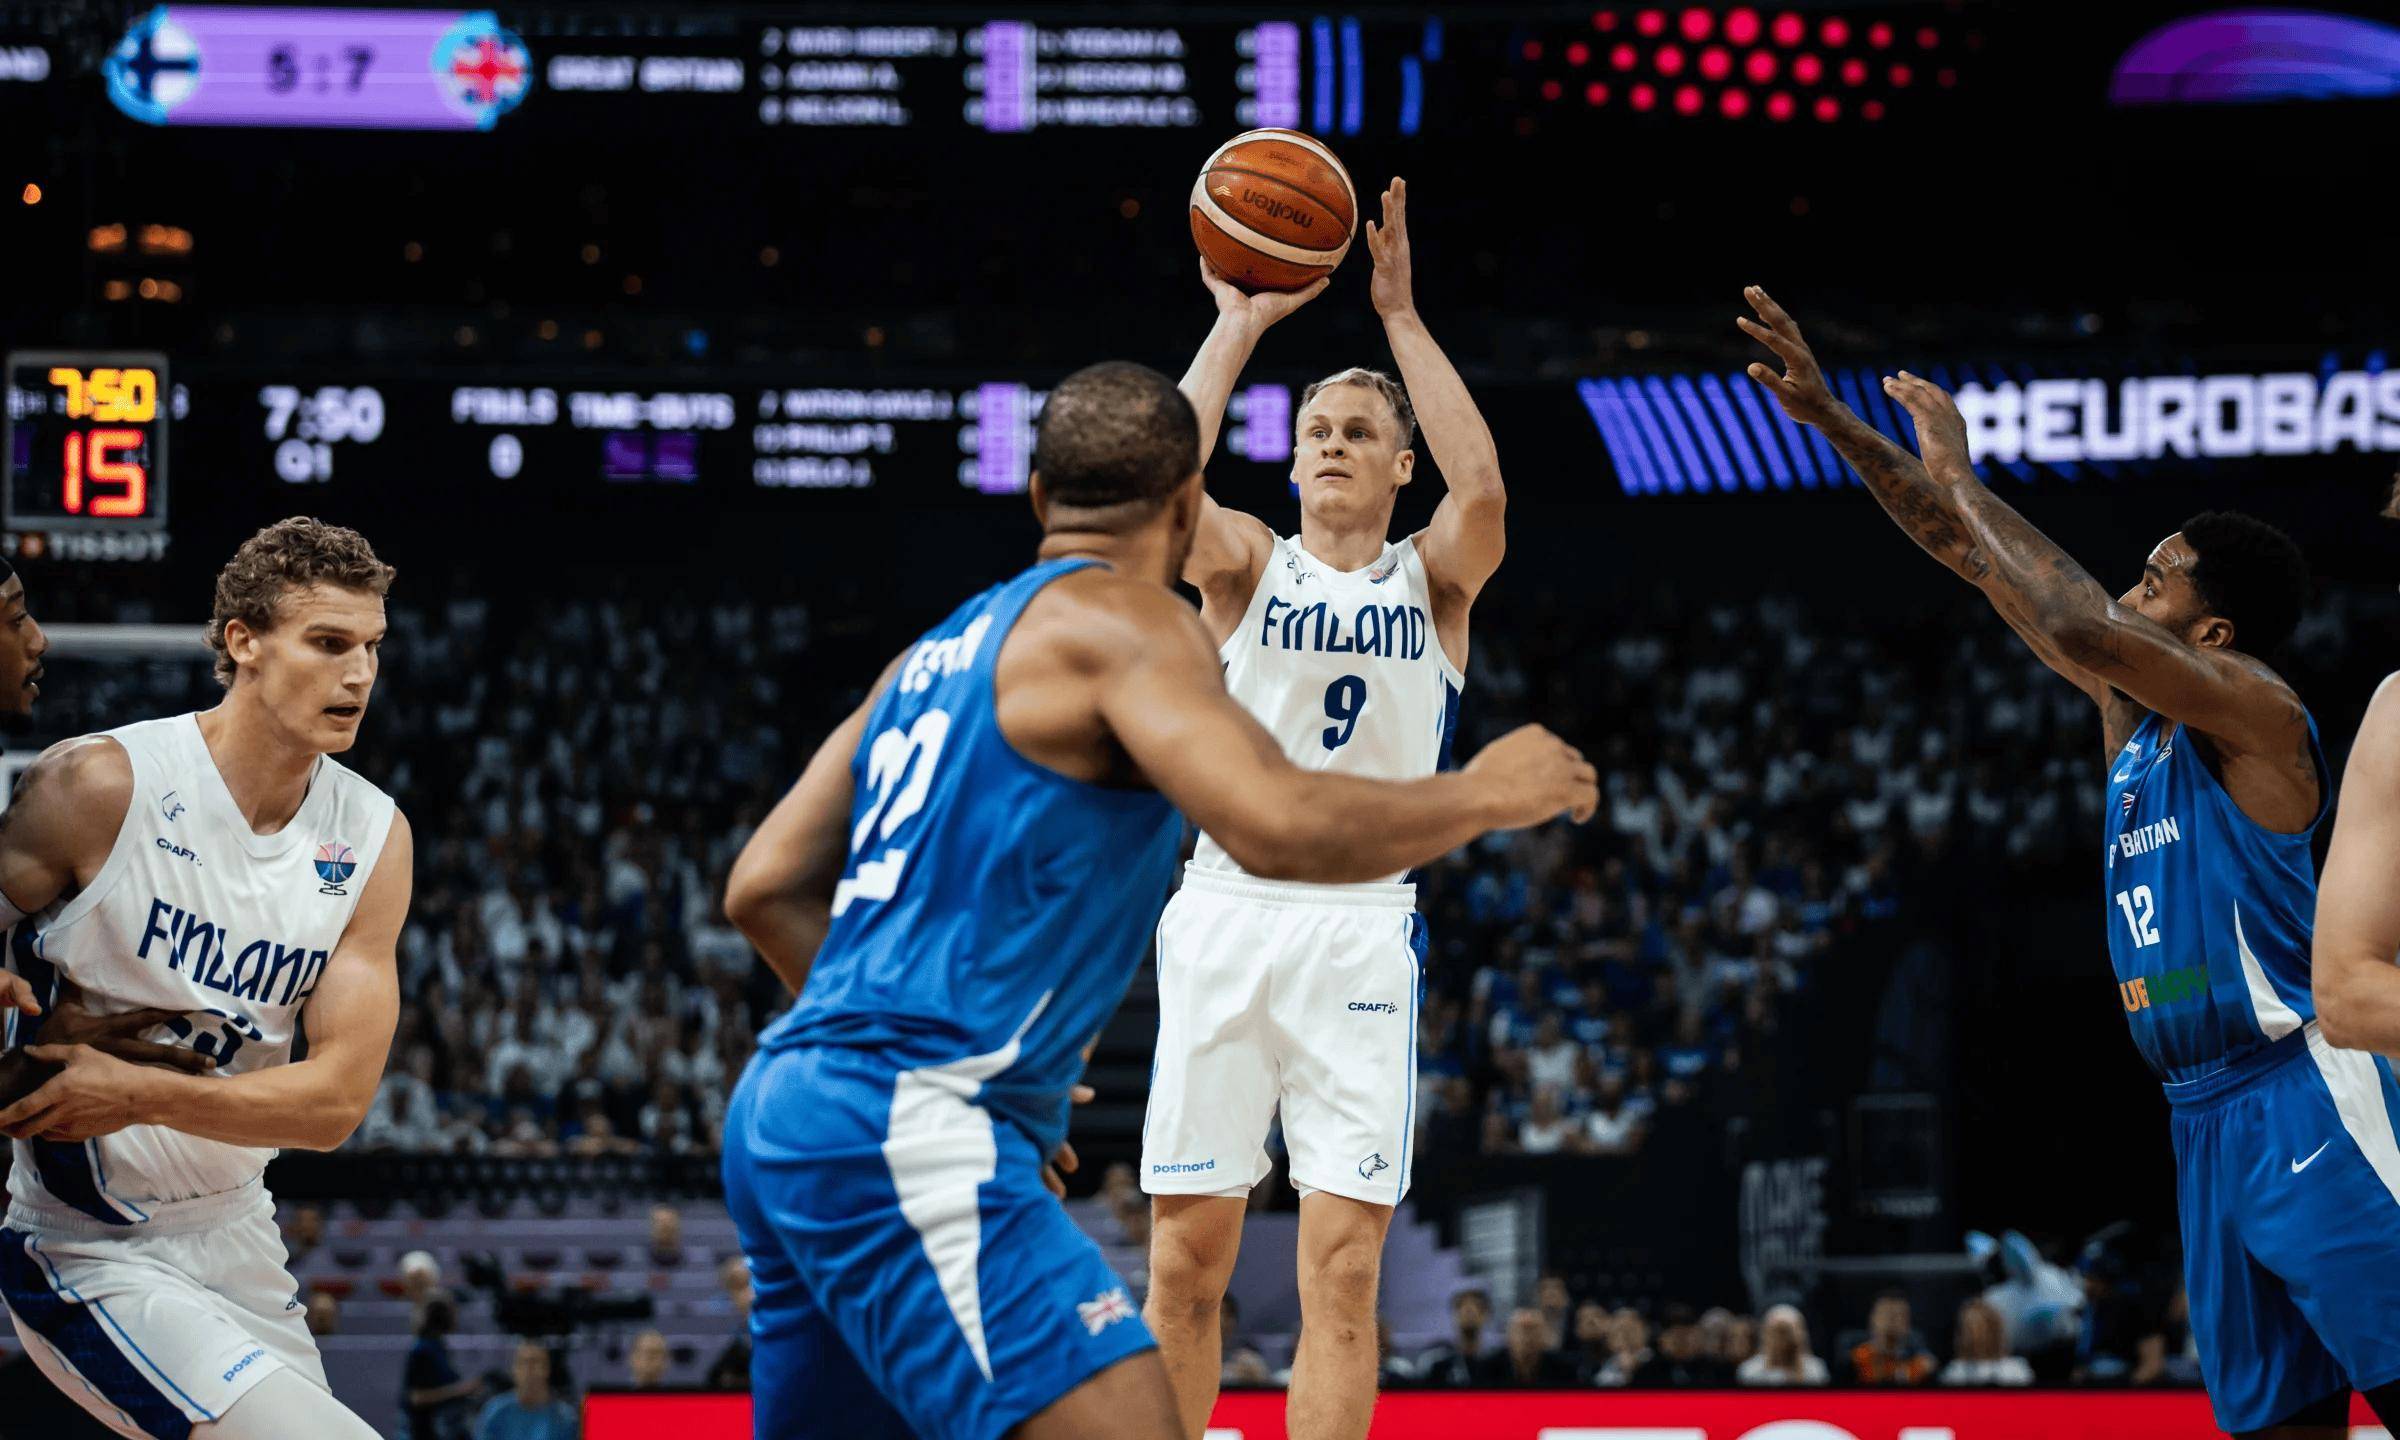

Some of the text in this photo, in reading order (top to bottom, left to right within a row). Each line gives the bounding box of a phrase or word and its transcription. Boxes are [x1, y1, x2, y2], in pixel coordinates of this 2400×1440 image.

[1243, 188, 1314, 229] molten
[48, 367, 157, 422] 7:50
[260, 386, 385, 443] 7:50
[63, 429, 147, 517] 15
[1262, 595, 1426, 660] FINLAND
[1322, 674, 1367, 751] 9
[156, 838, 197, 862] CRAFT
[2116, 884, 2161, 949] 12
[137, 897, 328, 1006] FINLAND
[1348, 1002, 1388, 1012] CRAFT
[1153, 1159, 1215, 1175] postnord
